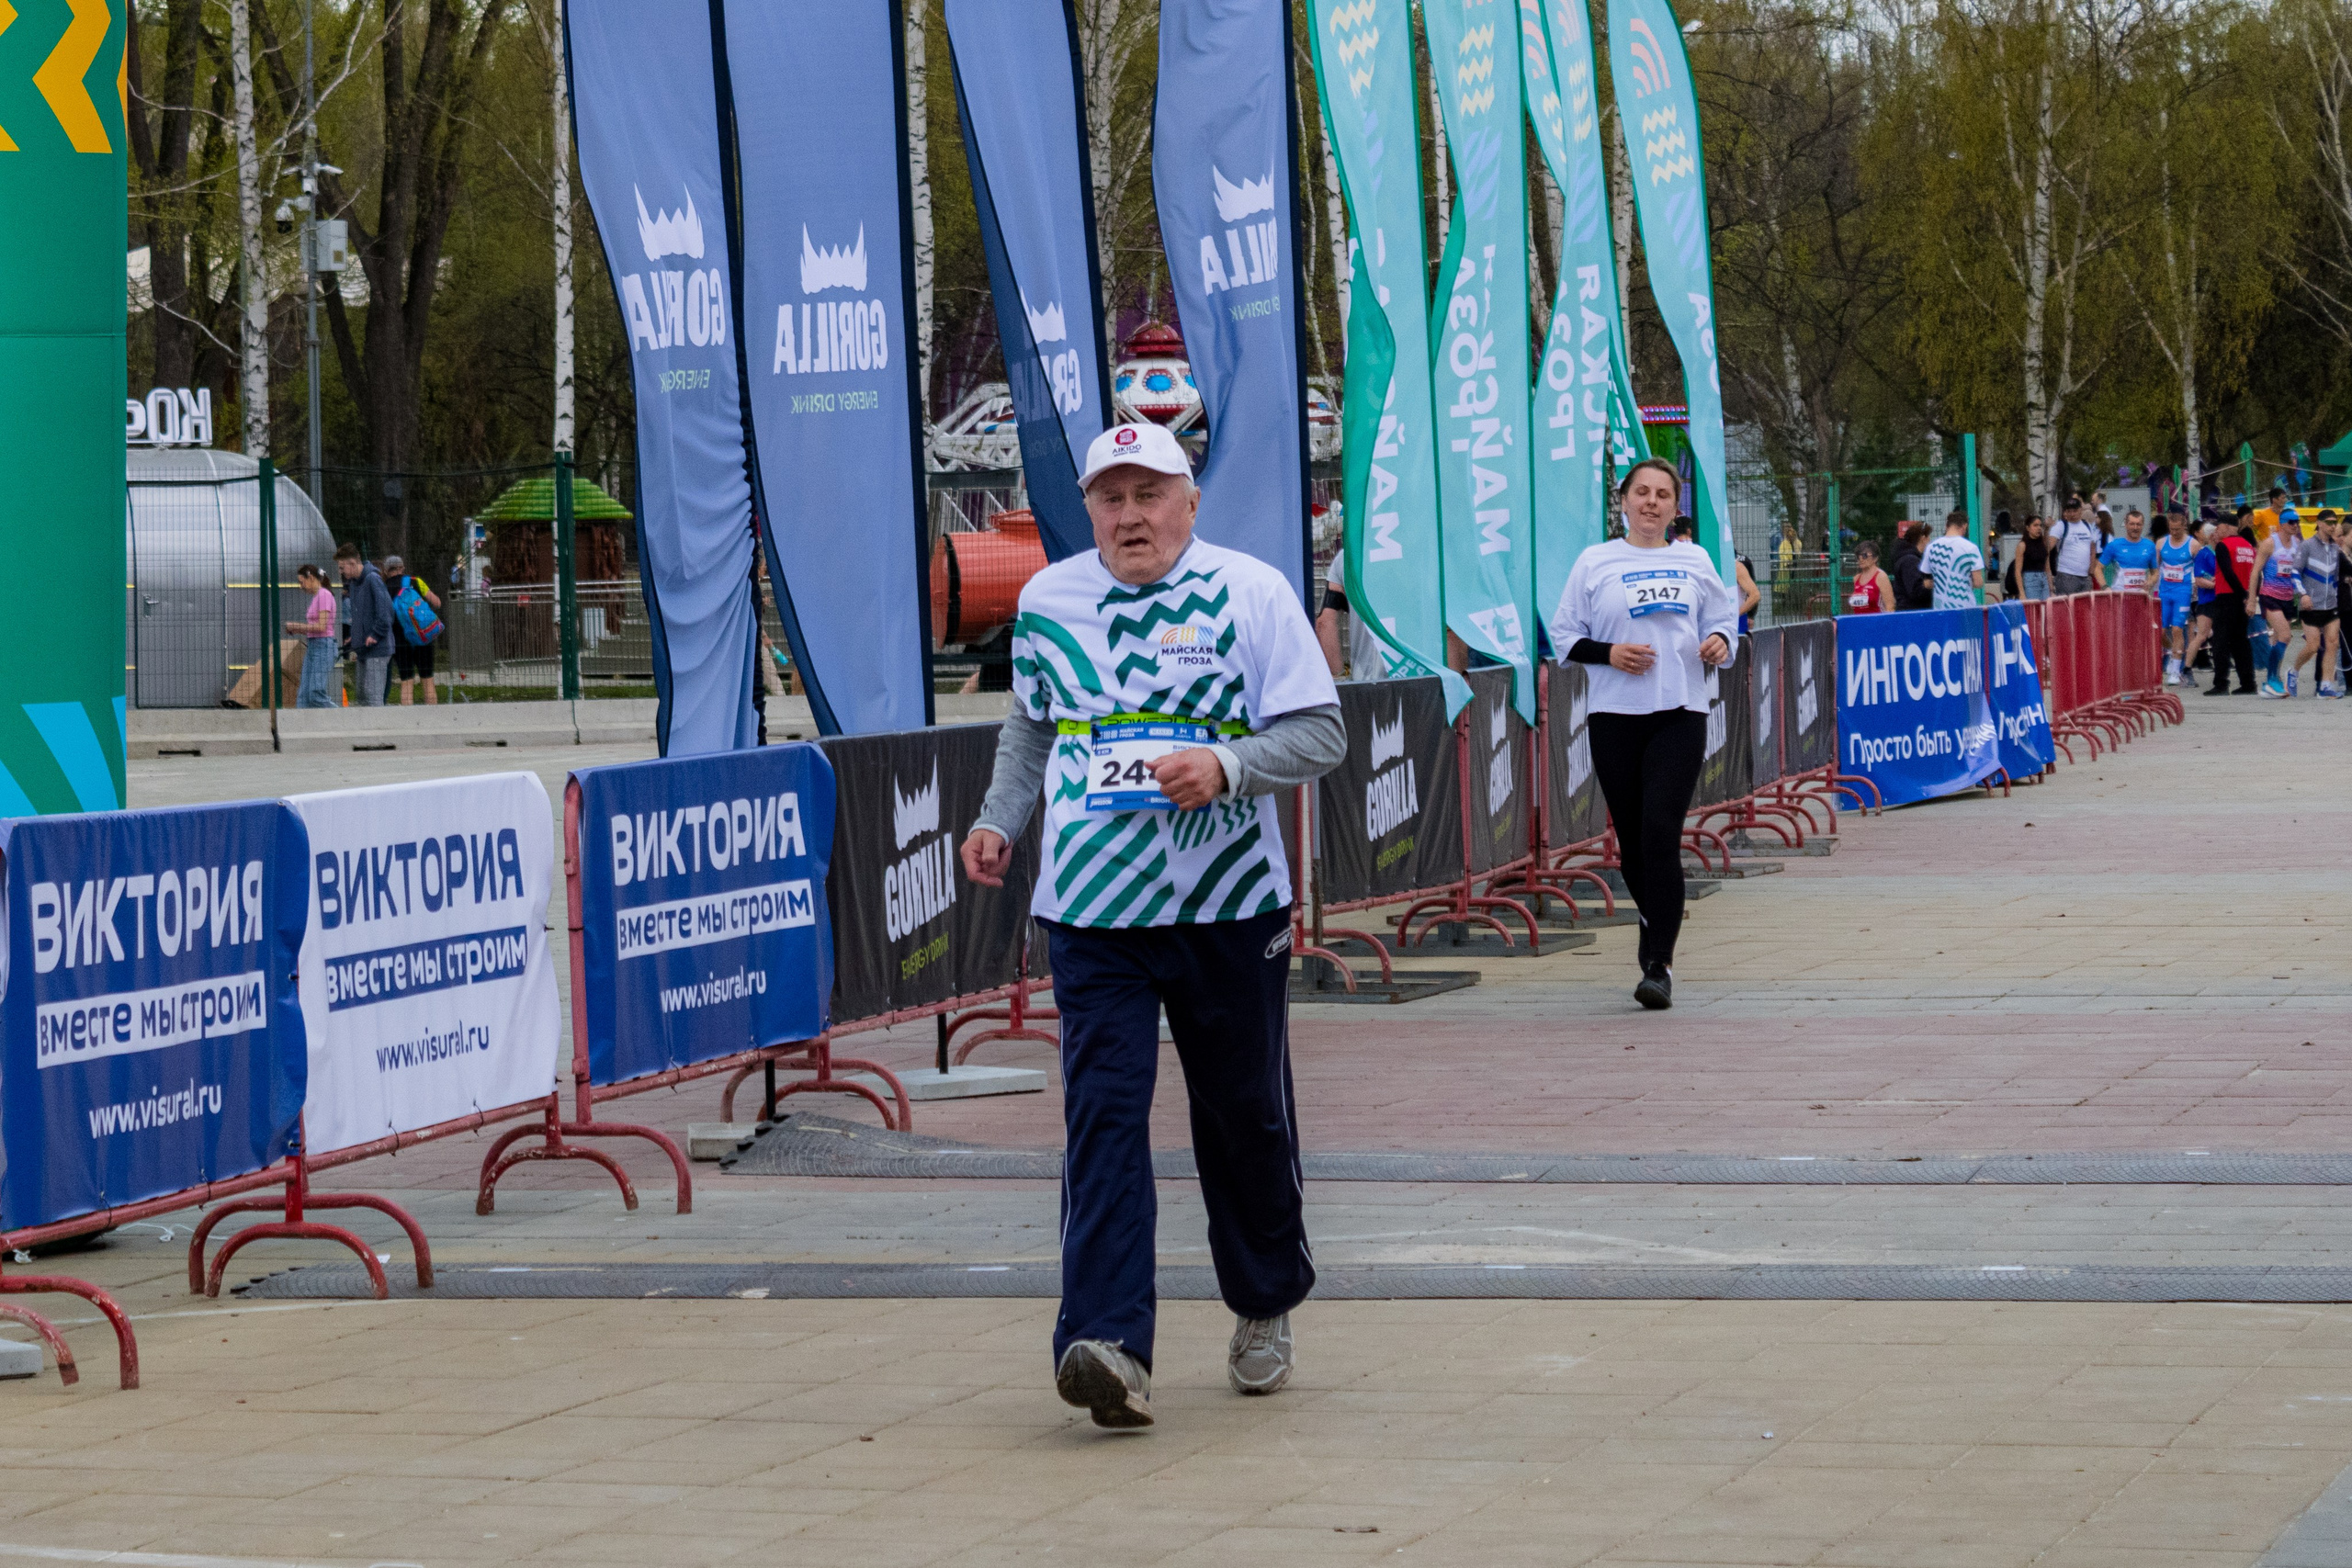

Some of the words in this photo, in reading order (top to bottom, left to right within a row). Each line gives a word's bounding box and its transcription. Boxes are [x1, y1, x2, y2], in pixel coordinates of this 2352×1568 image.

[1112, 444, 1142, 454] AIKIDO
[1636, 587, 1680, 604] 2147
[1160, 644, 1214, 657] МАЙСКАЯ
[1177, 656, 1214, 666] ГРОЗА
[1849, 731, 1913, 773] Просто
[1916, 725, 1952, 758] быть
[1366, 758, 1419, 842] GORILLA
[611, 792, 807, 886] ВИКТОРИЯ
[316, 828, 525, 931] ВИКТОРИЯ
[885, 831, 956, 942] GORILLA
[31, 860, 265, 974] ВИКТОРИЯ
[618, 906, 693, 951] вместе
[698, 901, 728, 936] мы
[730, 886, 811, 934] строим
[327, 950, 406, 1003] вместе
[409, 948, 442, 987] мы
[447, 931, 527, 985] строим
[900, 943, 931, 981] ENERGY
[931, 931, 950, 963] DRINK
[40, 1000, 131, 1056] вместе
[141, 999, 176, 1039] мы
[181, 980, 261, 1039] строим
[661, 965, 767, 1013] www.visural.ru
[377, 1021, 490, 1074] www.visural.ru
[90, 1078, 222, 1139] www.visural.ru
